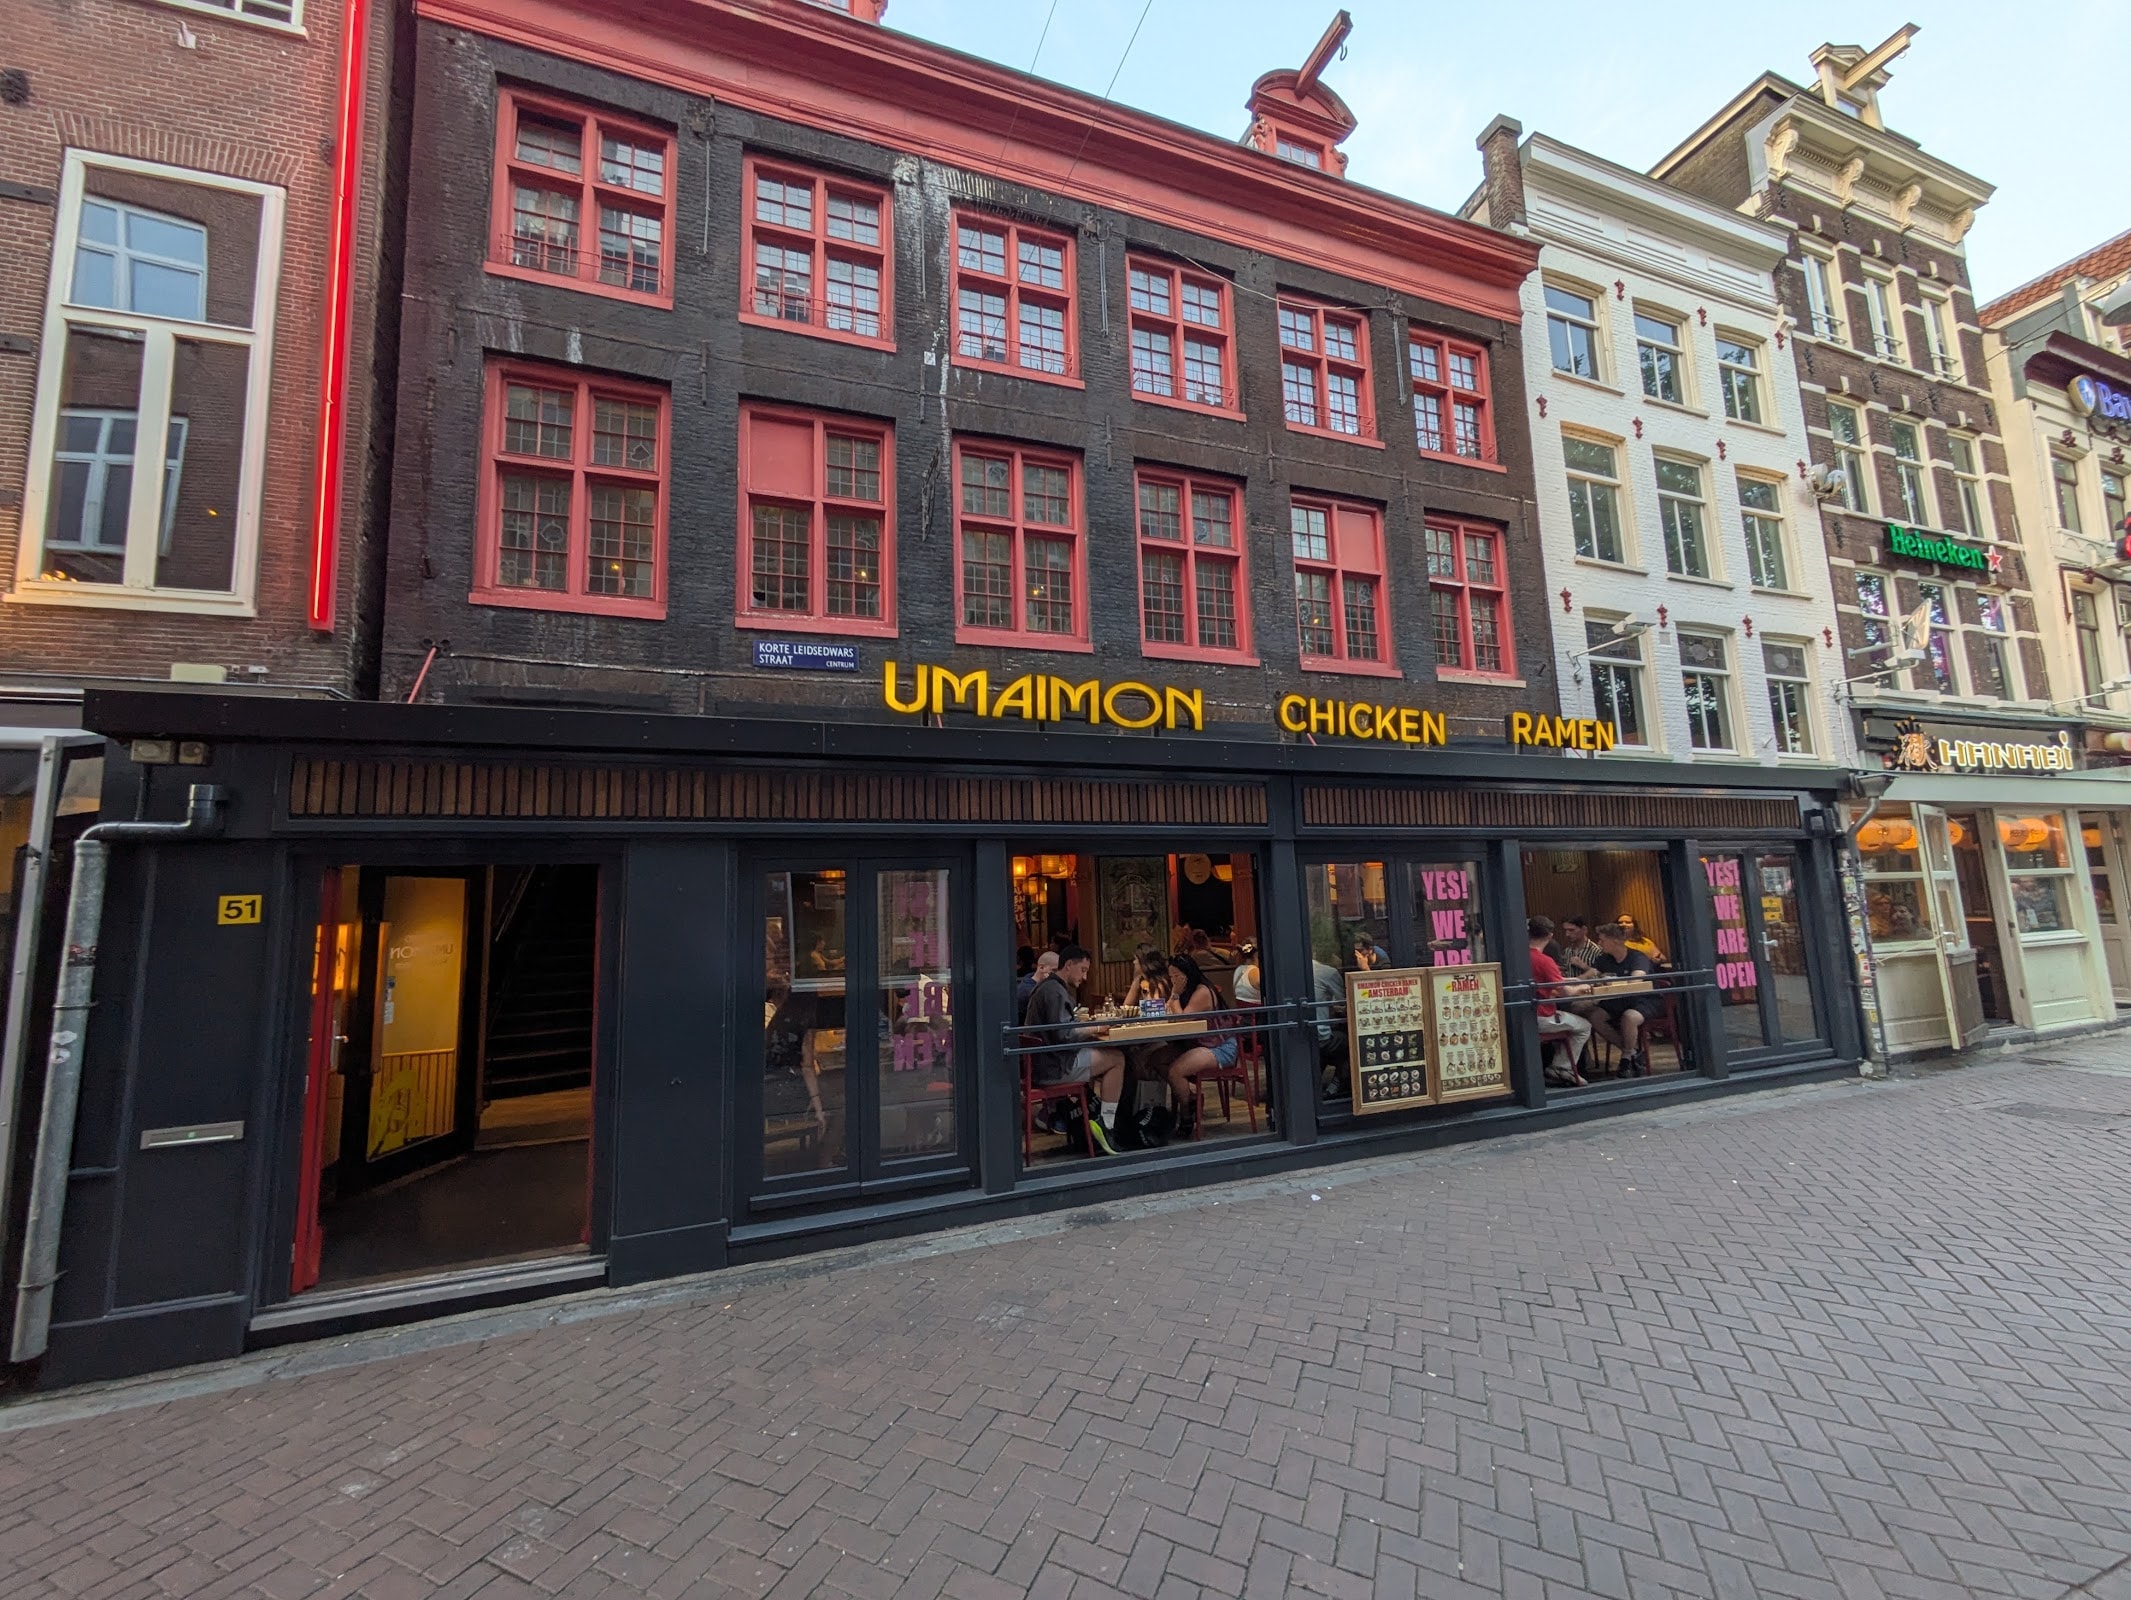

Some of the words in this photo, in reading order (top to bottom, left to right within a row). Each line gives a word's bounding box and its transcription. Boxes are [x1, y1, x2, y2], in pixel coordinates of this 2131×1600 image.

[1888, 523, 1985, 570] Heineken
[759, 642, 790, 654] KORTE
[793, 645, 854, 658] LEIDSEDWARS
[759, 654, 793, 665] STRAAT
[826, 660, 855, 668] CENTRUM
[883, 660, 1204, 731] UMAIMON
[1278, 694, 1447, 746] CHICKEN
[1511, 711, 1615, 751] RAMEN
[1421, 870, 1469, 900] YES!
[1704, 860, 1741, 887] YES!
[224, 899, 257, 920] 51
[1713, 895, 1740, 921] WE
[1431, 909, 1467, 941] WE
[1716, 928, 1748, 955] ARE
[1452, 979, 1479, 992] RAMEN
[1716, 961, 1757, 990] OPEN
[1368, 986, 1409, 998] AMSTERDAM
